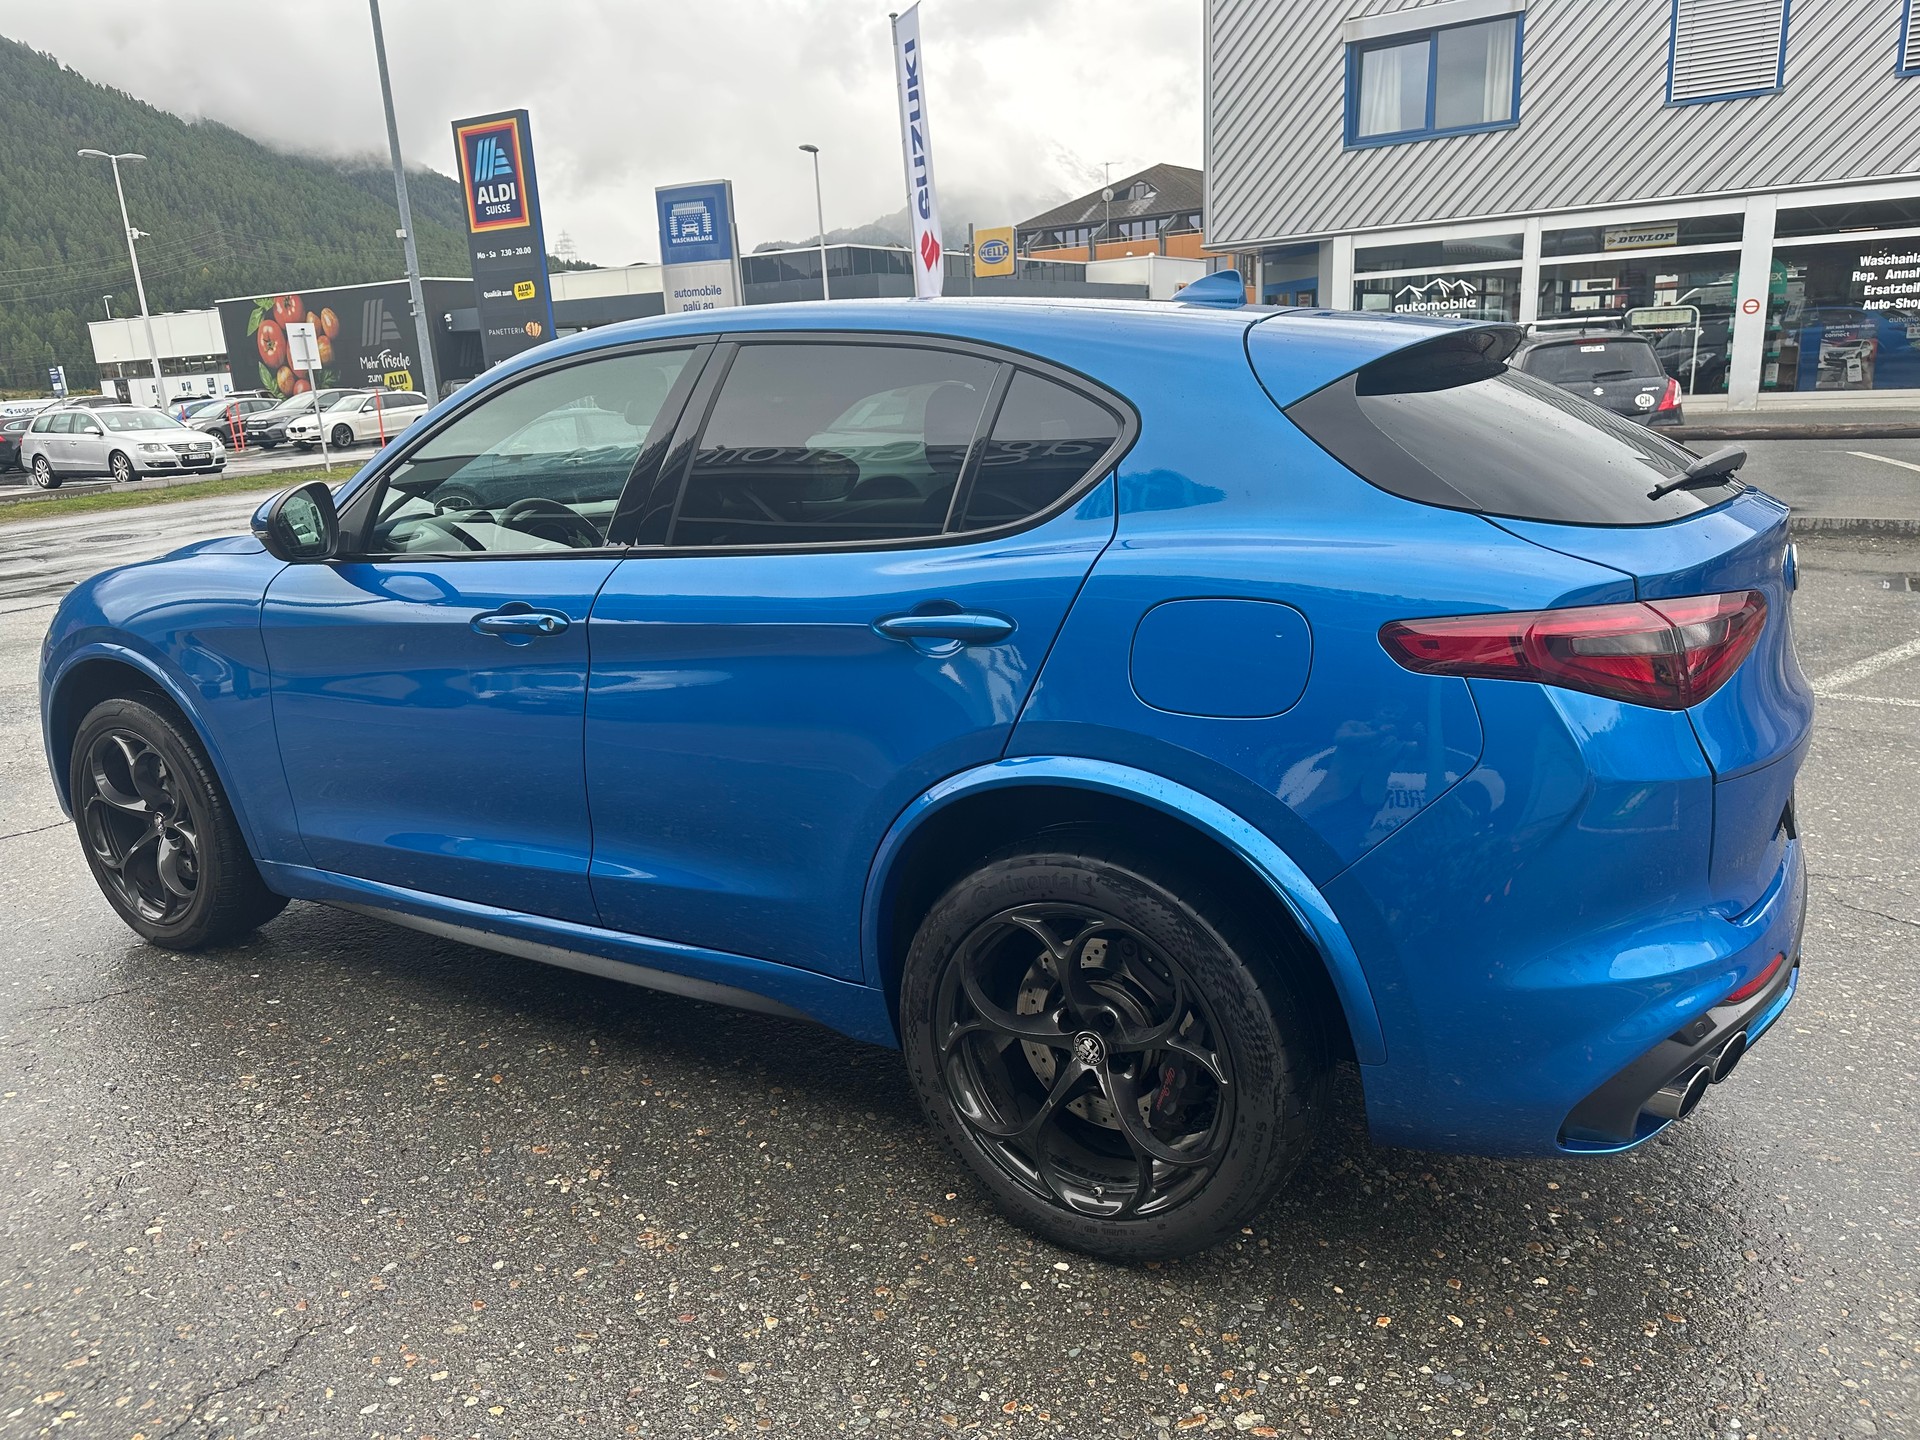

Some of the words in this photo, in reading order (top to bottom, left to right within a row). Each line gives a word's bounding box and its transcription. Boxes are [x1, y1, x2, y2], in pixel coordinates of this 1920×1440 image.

[904, 38, 931, 220] SUZUKI
[477, 182, 516, 205] ALDI
[485, 203, 511, 216] SUISSE
[671, 234, 713, 244] WASCHANLAGE
[1617, 232, 1675, 244] DUNLOP
[476, 251, 486, 260] Mo
[489, 250, 497, 259] Sa
[980, 245, 1009, 257] HELLA
[1852, 271, 1879, 283] Rep.
[517, 282, 532, 292] ALDI
[674, 284, 722, 299] automobile
[683, 301, 701, 312] palü
[1394, 298, 1477, 314] automobile
[488, 327, 525, 336] PANETTERIA
[359, 356, 379, 370] Mehr
[377, 348, 411, 370] Frische
[367, 374, 383, 383] zum
[389, 373, 408, 386] ALDI
[1639, 395, 1651, 405] CH
